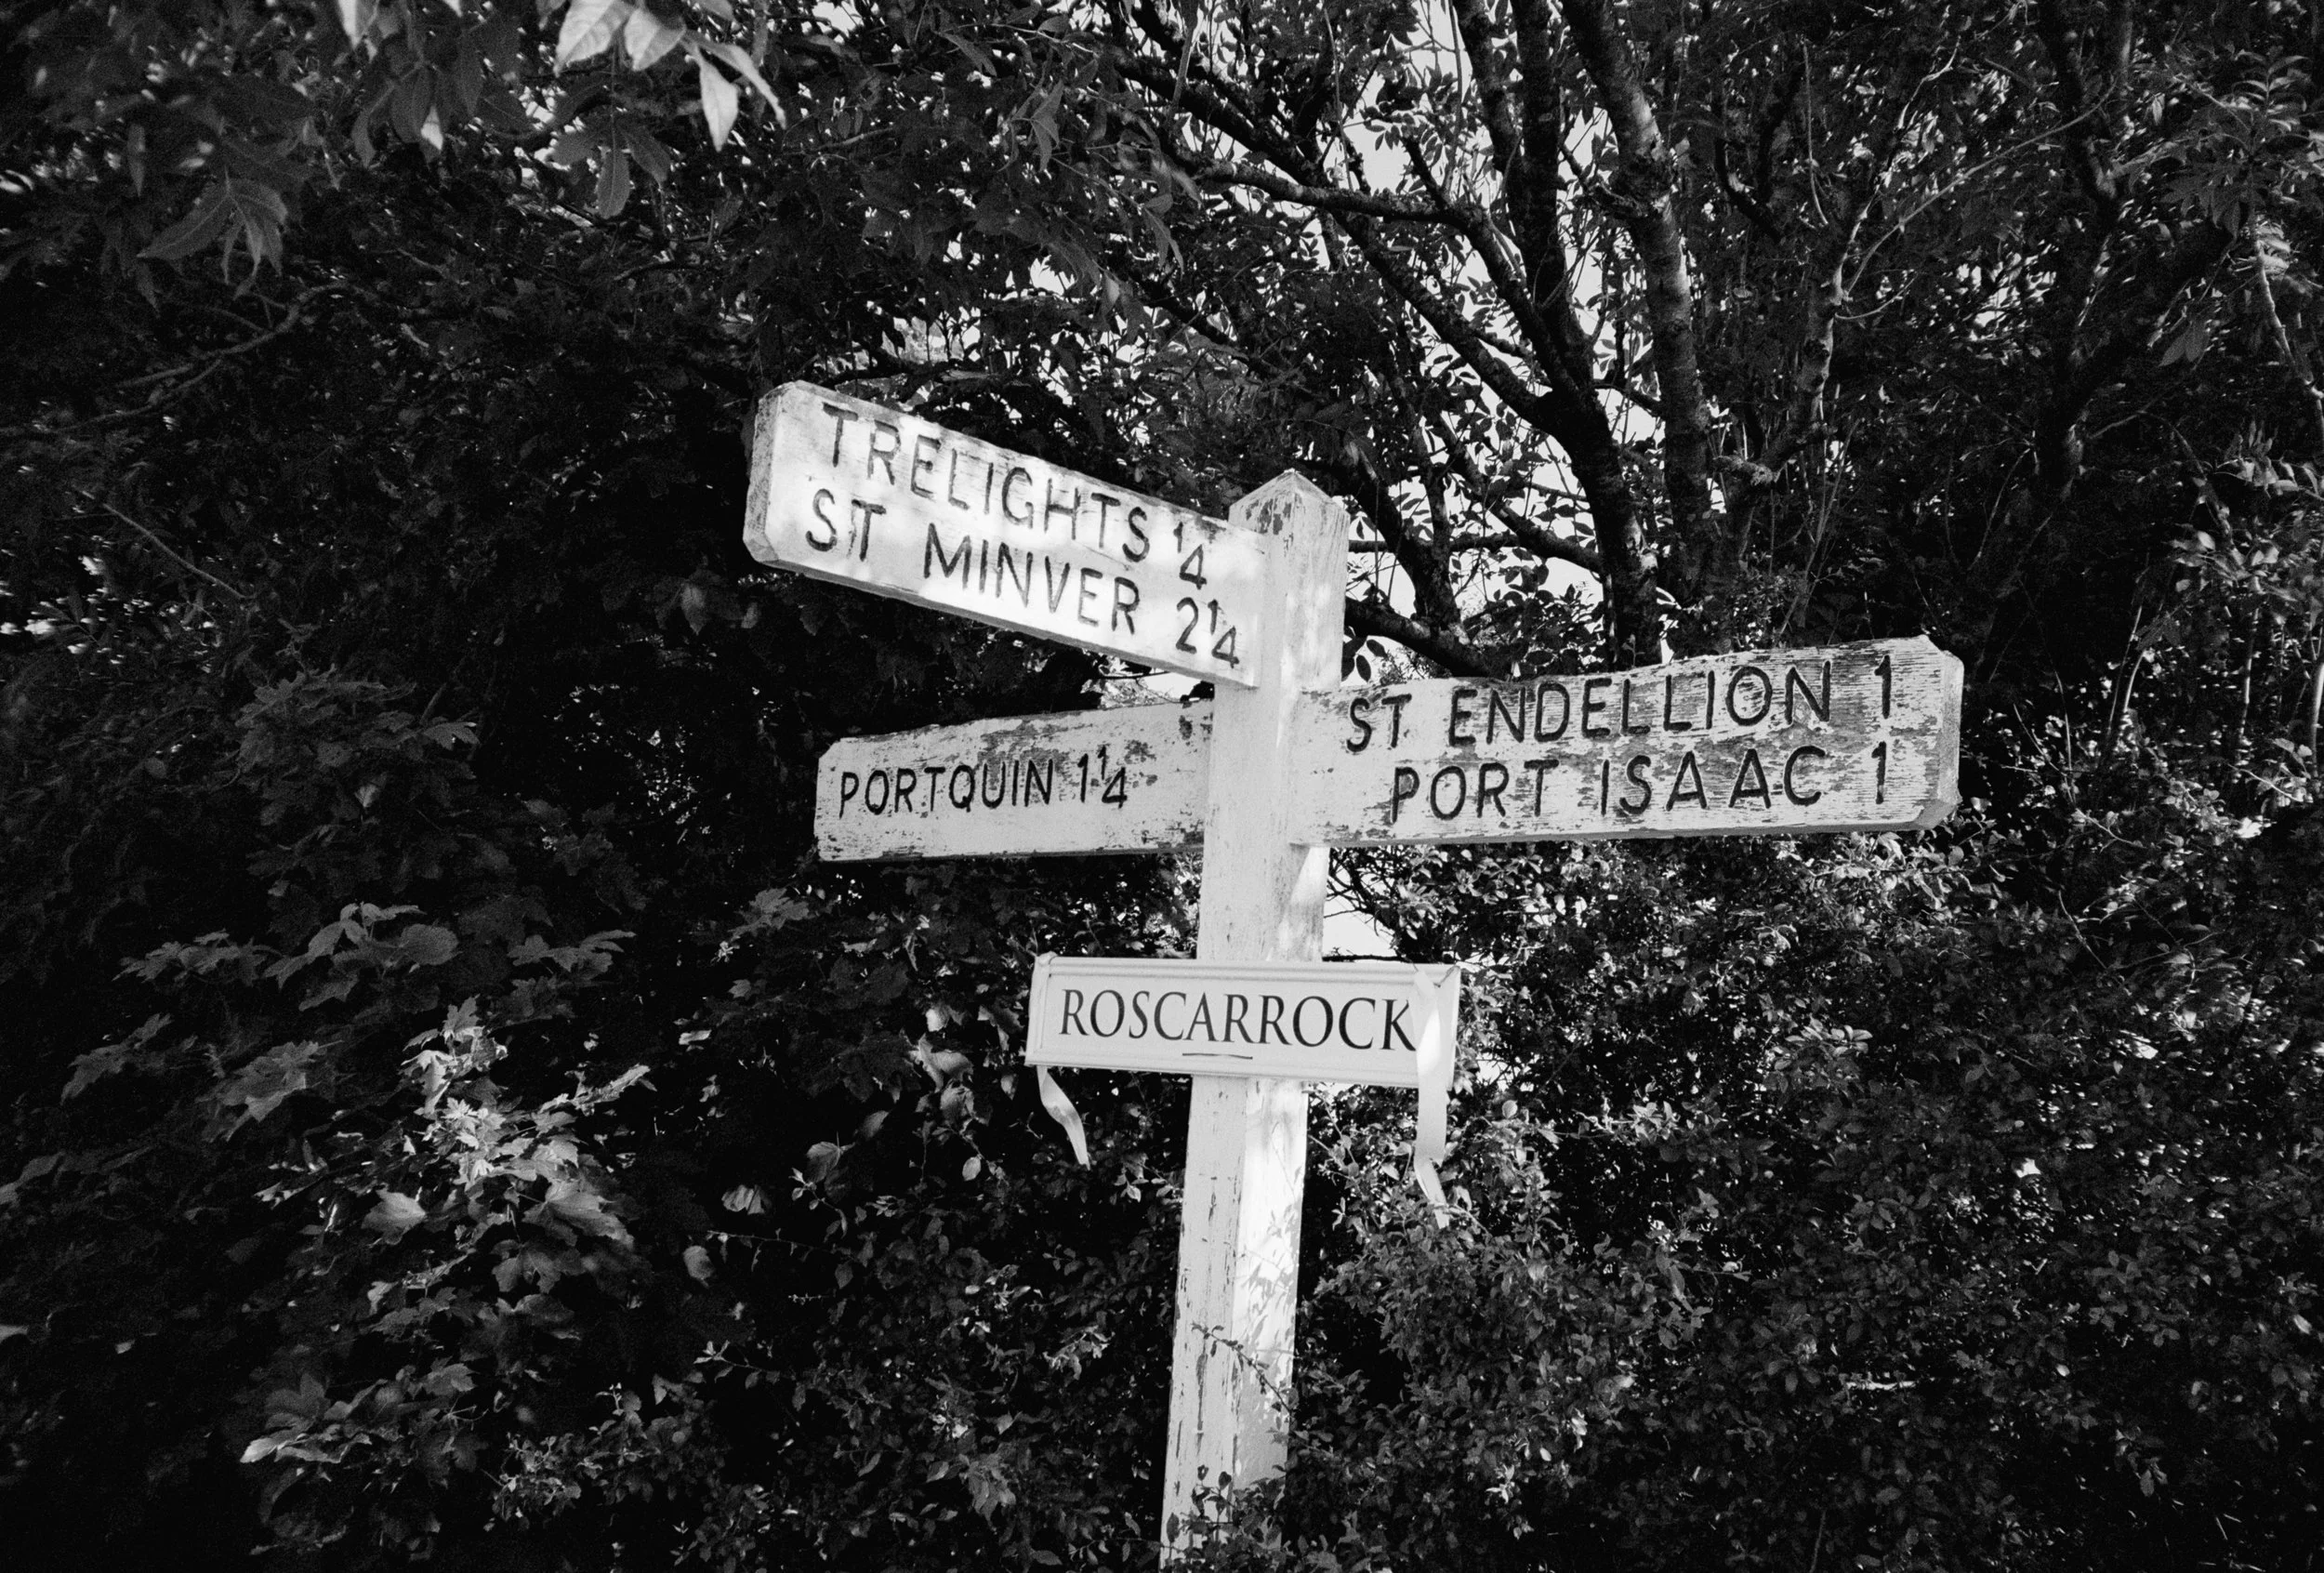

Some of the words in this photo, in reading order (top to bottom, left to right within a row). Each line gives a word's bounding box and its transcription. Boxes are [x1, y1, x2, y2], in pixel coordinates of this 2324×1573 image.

[823, 401, 1150, 562] TRELIGHTS
[804, 488, 887, 562] ST
[923, 522, 1140, 635] MINVER
[1346, 694, 1412, 753] ST
[1448, 660, 1831, 745] ENDELLION
[1873, 654, 1892, 719] 1
[838, 759, 1053, 819] PORTQUIN
[1391, 759, 1559, 823] PORT
[1601, 745, 1826, 816] ISAAC
[1870, 740, 1887, 805] 1
[1058, 988, 1416, 1051] ROSCARROCK
